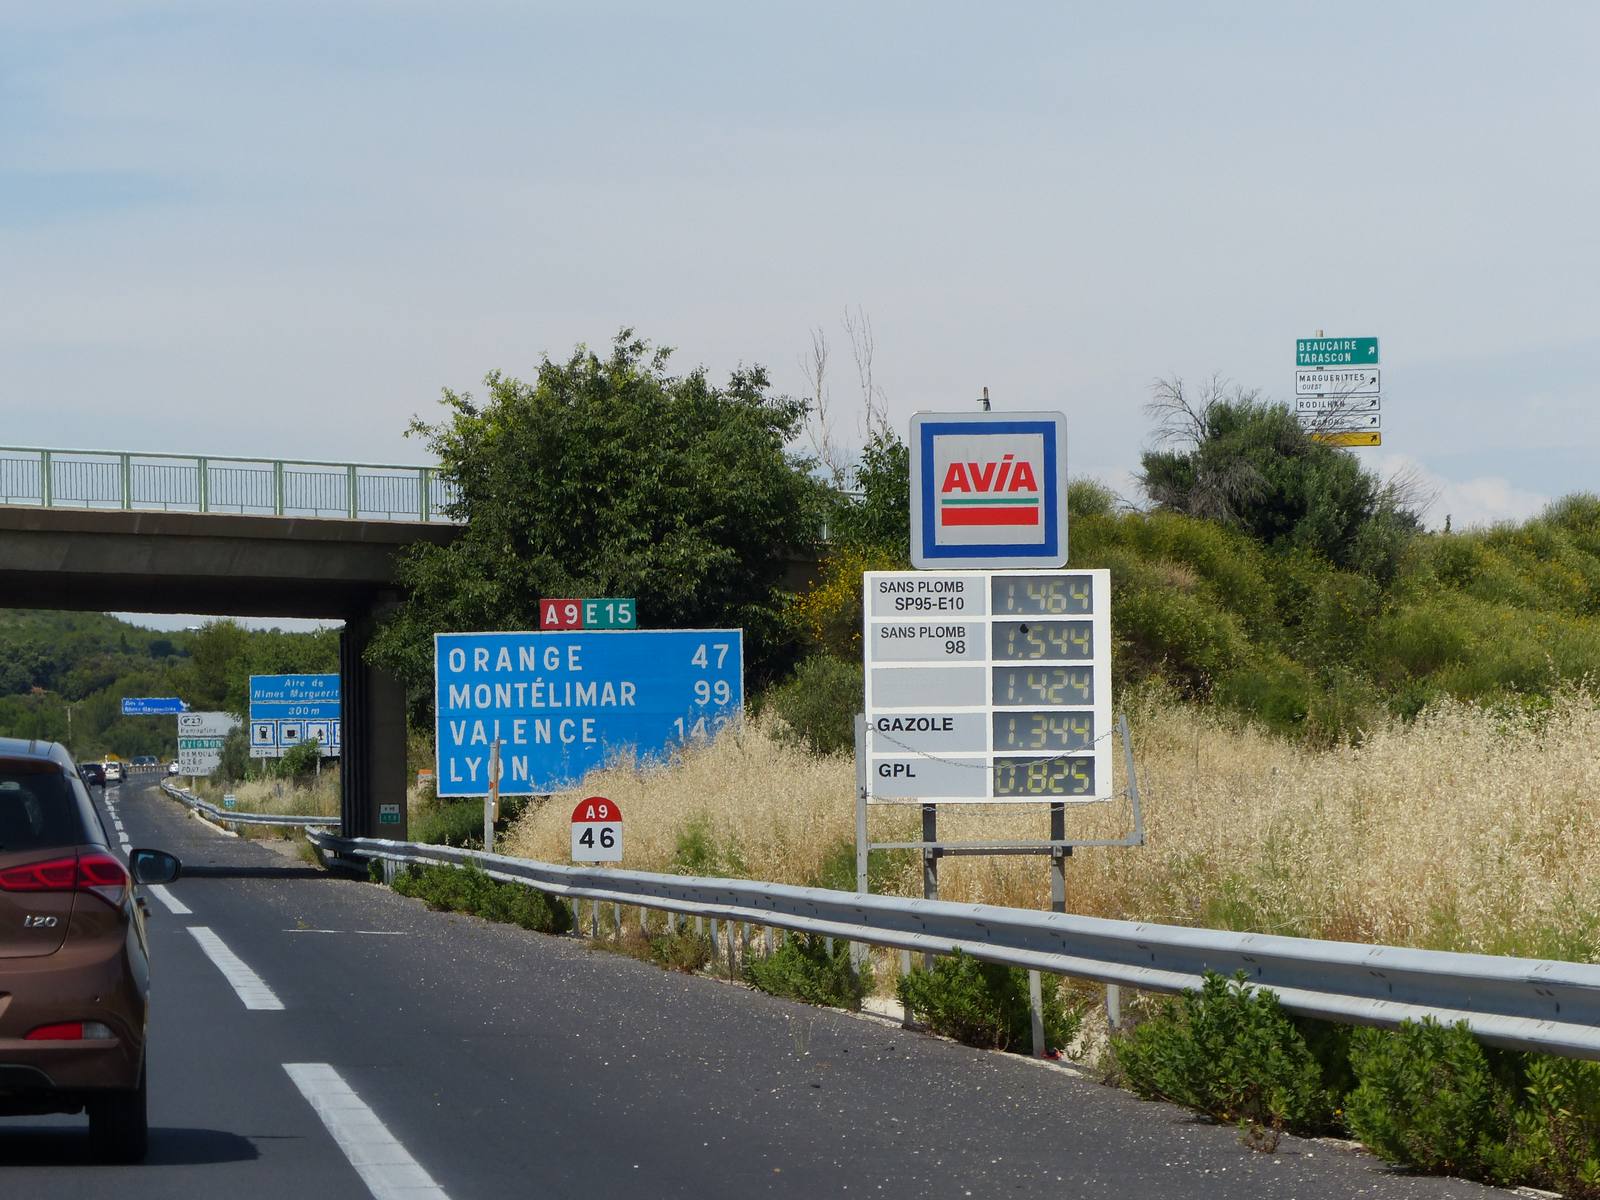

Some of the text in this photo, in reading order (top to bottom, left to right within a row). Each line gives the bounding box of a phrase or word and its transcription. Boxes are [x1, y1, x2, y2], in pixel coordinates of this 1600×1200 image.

[1299, 341, 1357, 351] BEAUCAIRE
[1299, 352, 1352, 363] TARASCON
[1299, 373, 1365, 383] MARGUERITTES
[879, 581, 965, 594] SANS PLOMB
[894, 596, 965, 611] SP95-E10
[880, 626, 966, 639] SANS PLOMB
[944, 640, 967, 655] 98
[448, 645, 583, 674] ORANGE
[691, 643, 730, 670] 47
[448, 677, 637, 710] MONTÉLIMAR
[693, 679, 731, 706] 99
[449, 717, 597, 746] VALENCE
[877, 717, 954, 732] GAZOLE
[878, 763, 917, 778] GPL
[578, 827, 616, 849] 46
